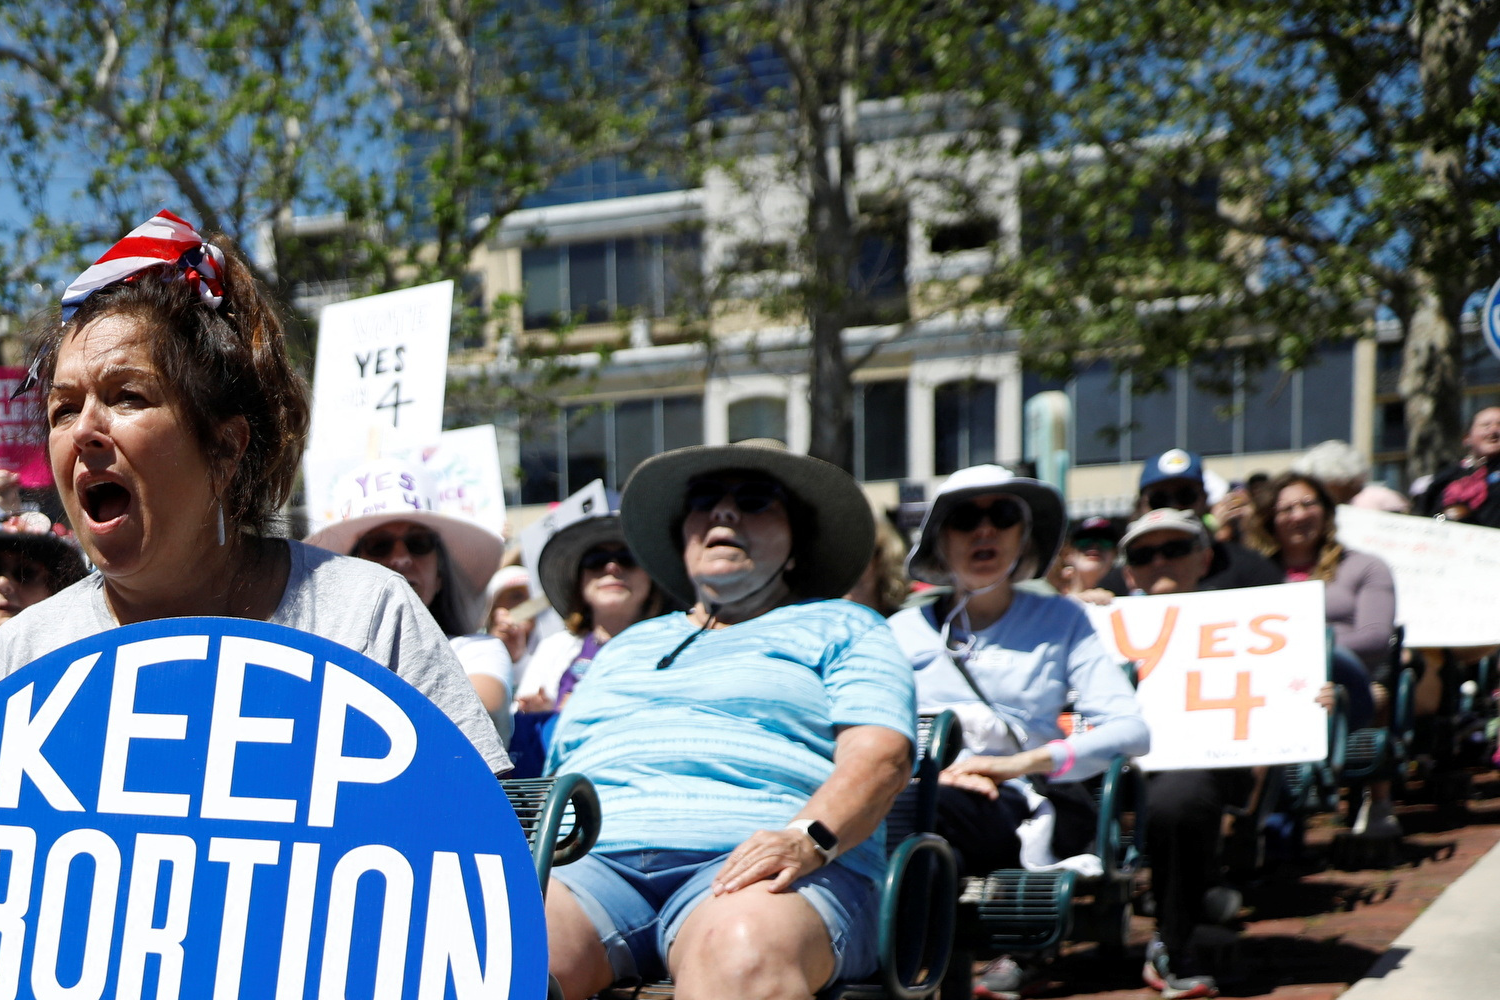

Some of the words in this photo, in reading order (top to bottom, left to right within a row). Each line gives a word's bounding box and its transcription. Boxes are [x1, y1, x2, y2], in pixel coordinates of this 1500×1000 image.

[354, 344, 407, 379] YES
[375, 380, 414, 428] 4
[355, 471, 416, 498] YES
[1110, 604, 1290, 682] YES
[1185, 670, 1266, 741] 4
